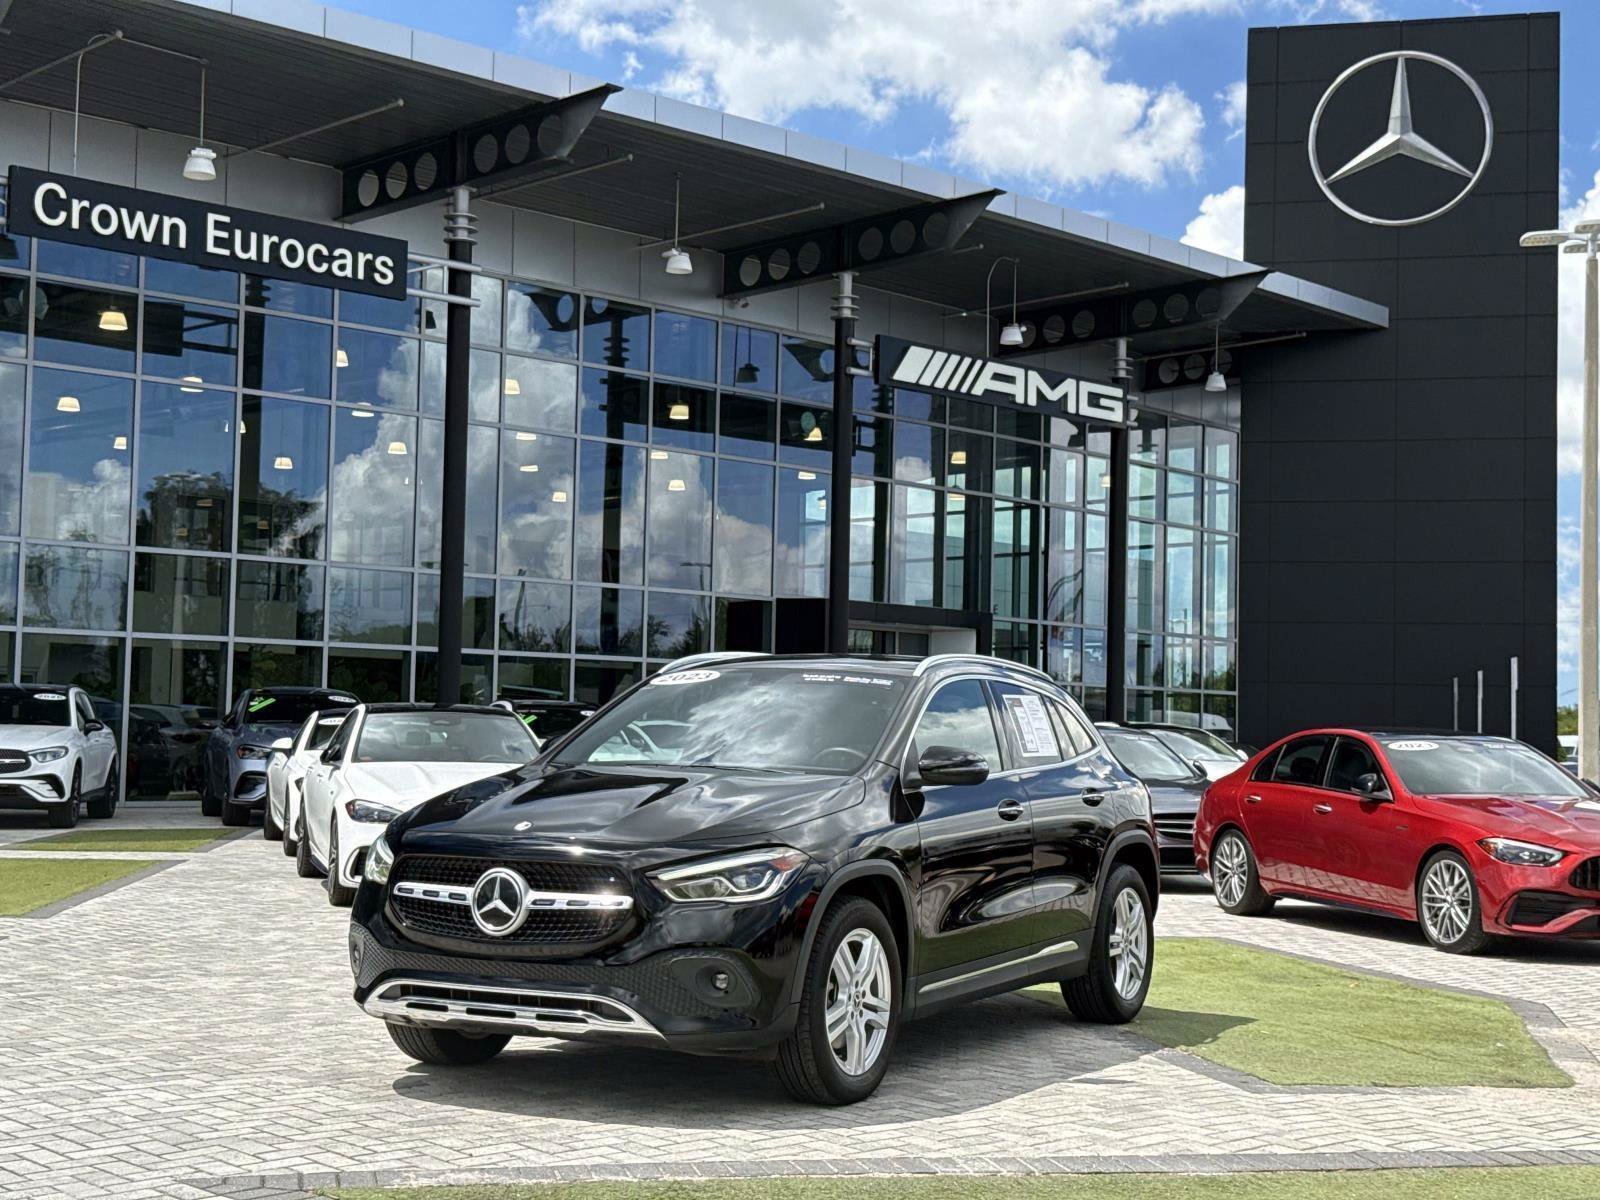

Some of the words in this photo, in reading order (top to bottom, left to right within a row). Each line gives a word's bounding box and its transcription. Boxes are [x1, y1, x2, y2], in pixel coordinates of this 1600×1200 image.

[33, 181, 188, 250] Crown
[205, 213, 395, 286] Eurocars
[970, 360, 1124, 424] AMG
[656, 671, 714, 683] 2023
